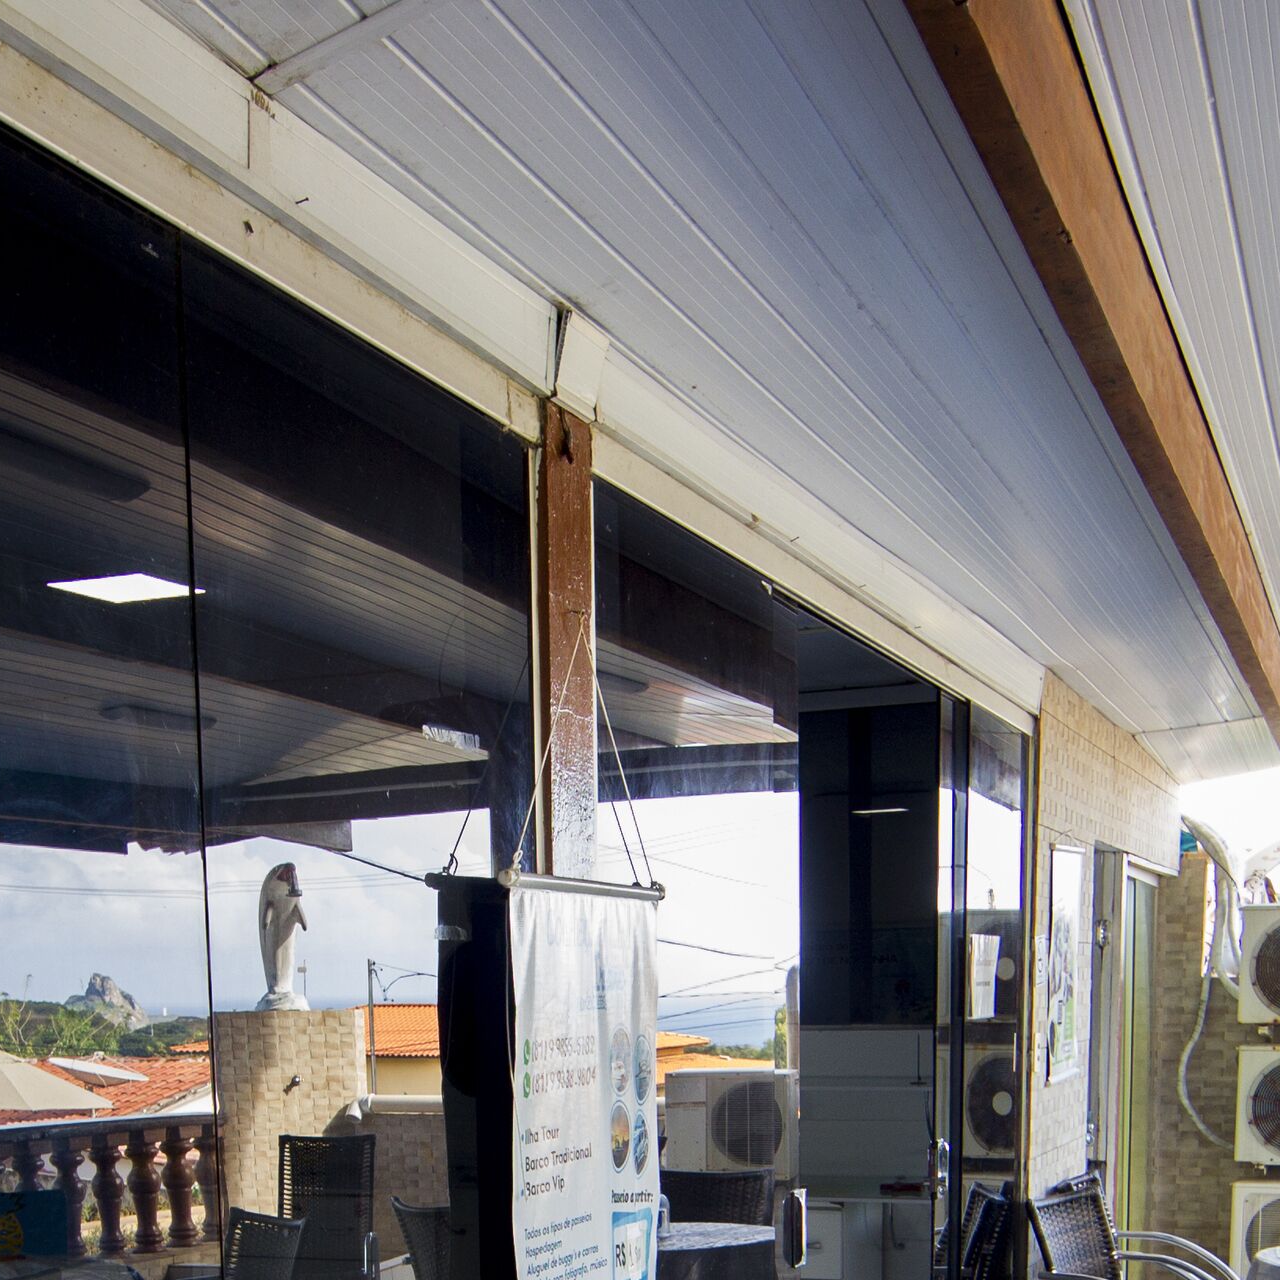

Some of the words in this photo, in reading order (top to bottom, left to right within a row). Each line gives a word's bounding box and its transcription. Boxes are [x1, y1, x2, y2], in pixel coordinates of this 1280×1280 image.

[541, 1126, 560, 1141] Tour
[525, 1156, 549, 1172] Barco
[551, 1142, 592, 1165] Tradicional
[525, 1181, 550, 1197] Barco
[552, 1174, 565, 1193] Vip
[524, 1226, 541, 1240] Todos
[542, 1227, 549, 1236] os
[564, 1217, 570, 1228] de
[525, 1240, 562, 1260] Hospedagem
[551, 1256, 557, 1268] de
